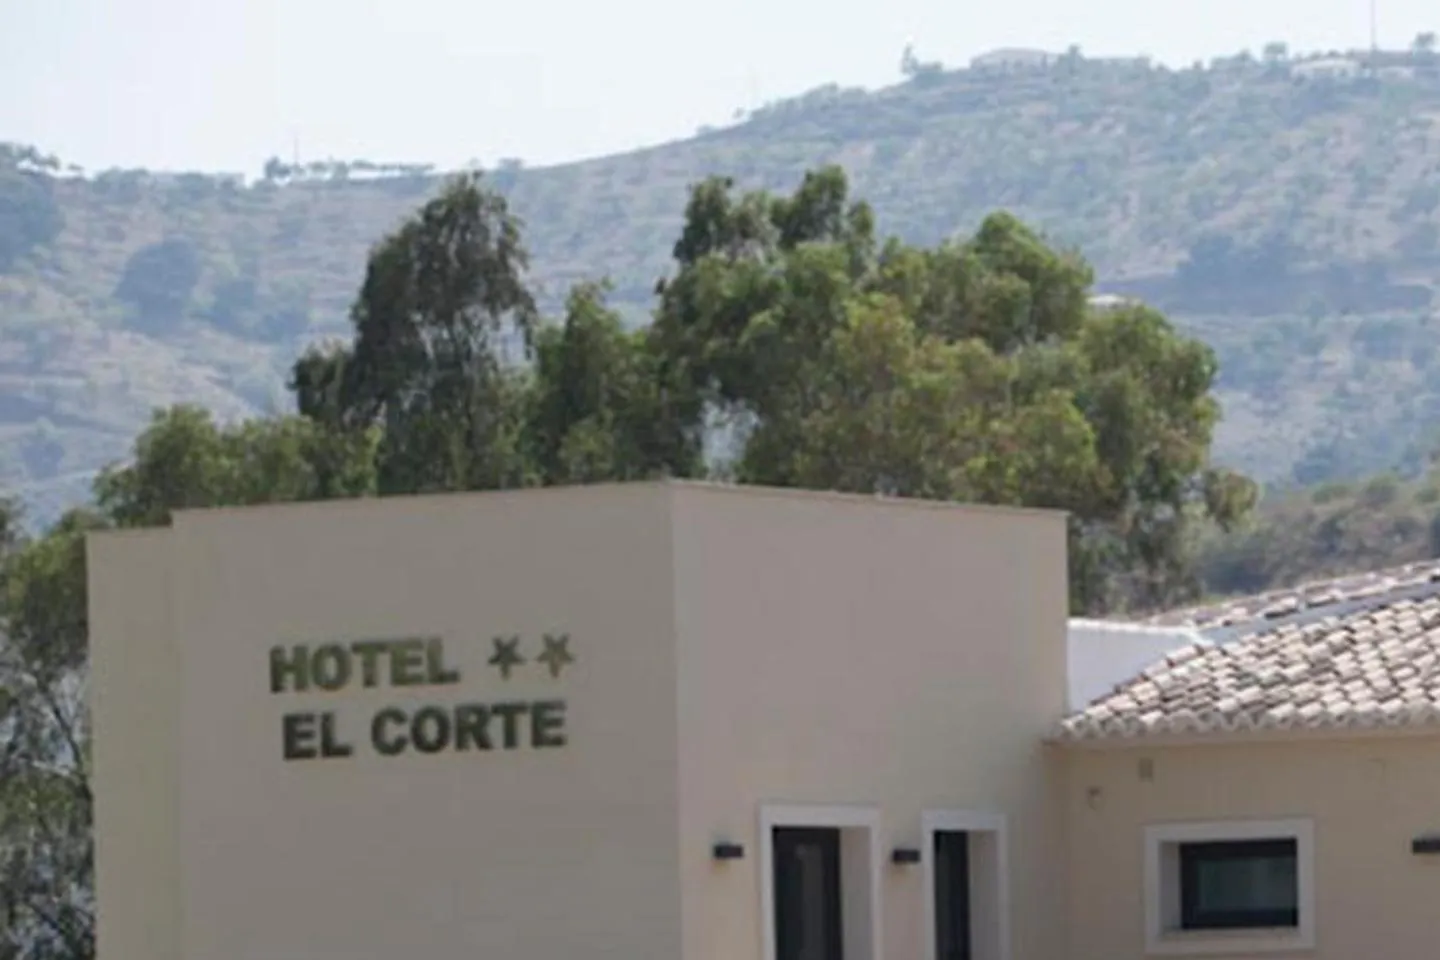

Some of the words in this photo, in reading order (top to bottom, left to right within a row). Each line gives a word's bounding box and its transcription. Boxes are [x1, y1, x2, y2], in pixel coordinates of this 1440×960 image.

[269, 637, 460, 694] HOTEL
[282, 711, 354, 761] EL
[370, 700, 568, 756] CORTE
